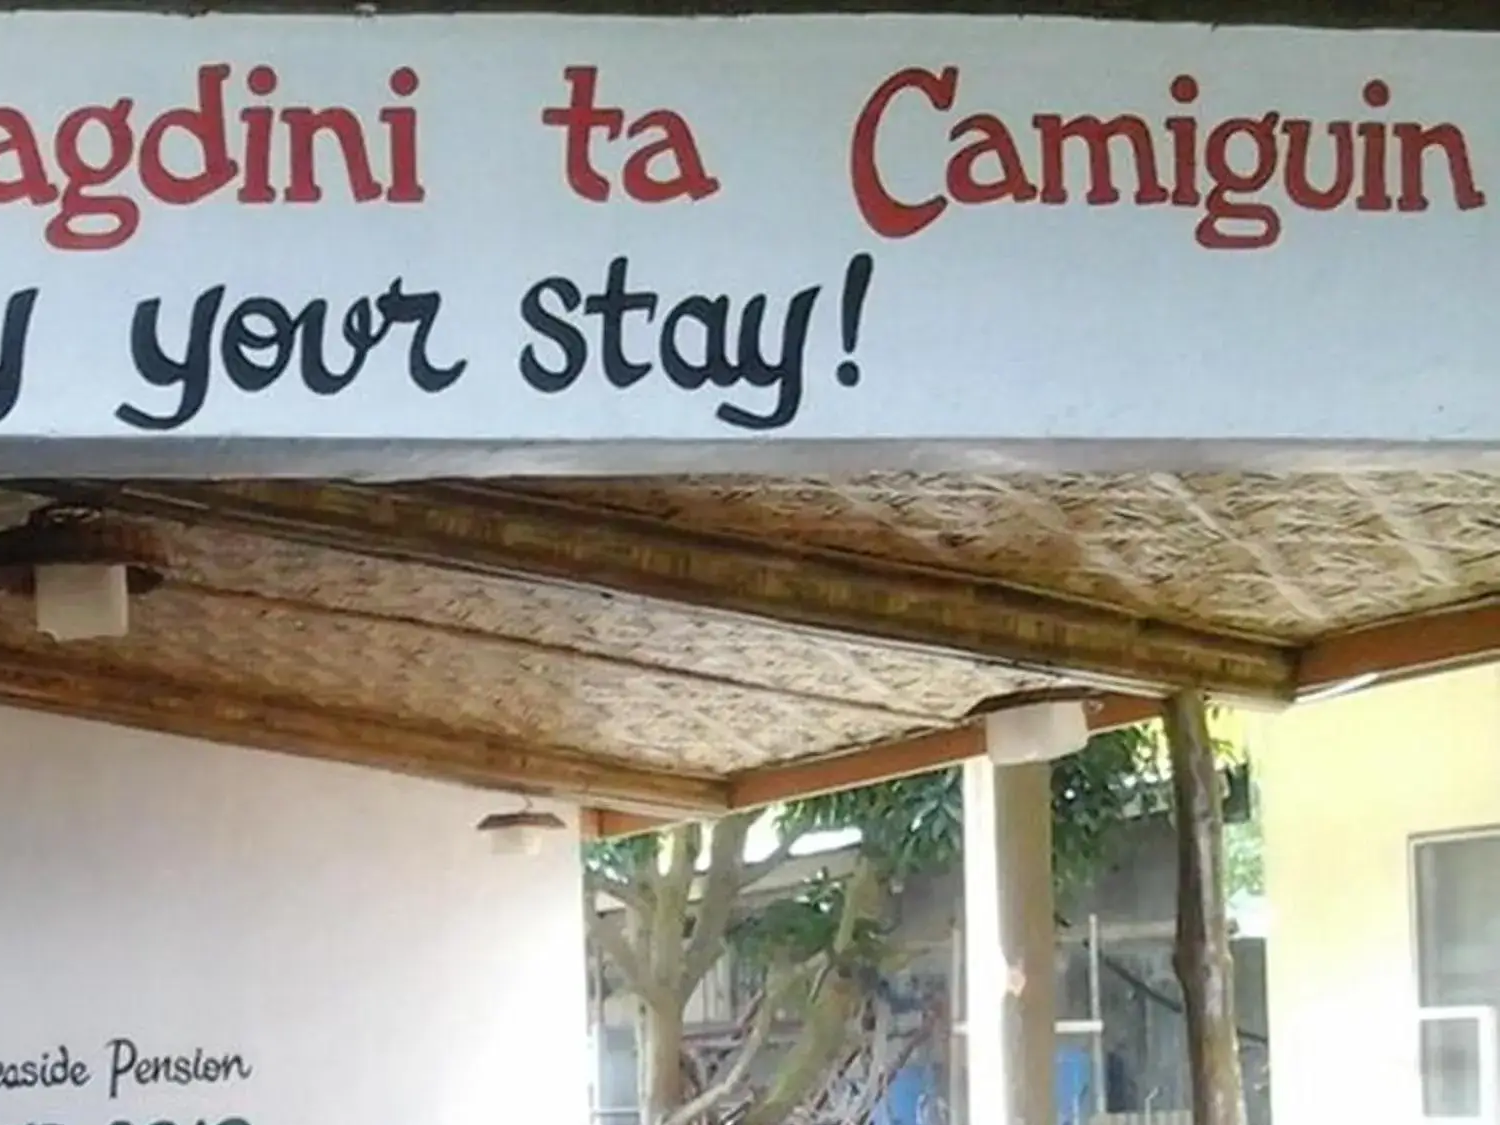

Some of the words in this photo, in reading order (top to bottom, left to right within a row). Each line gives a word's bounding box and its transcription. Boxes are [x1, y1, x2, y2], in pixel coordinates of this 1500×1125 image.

[542, 66, 718, 202] ta
[849, 66, 1486, 250] Camiguin
[113, 276, 467, 432] your
[518, 252, 876, 432] stay!
[105, 1037, 253, 1099] Pension
